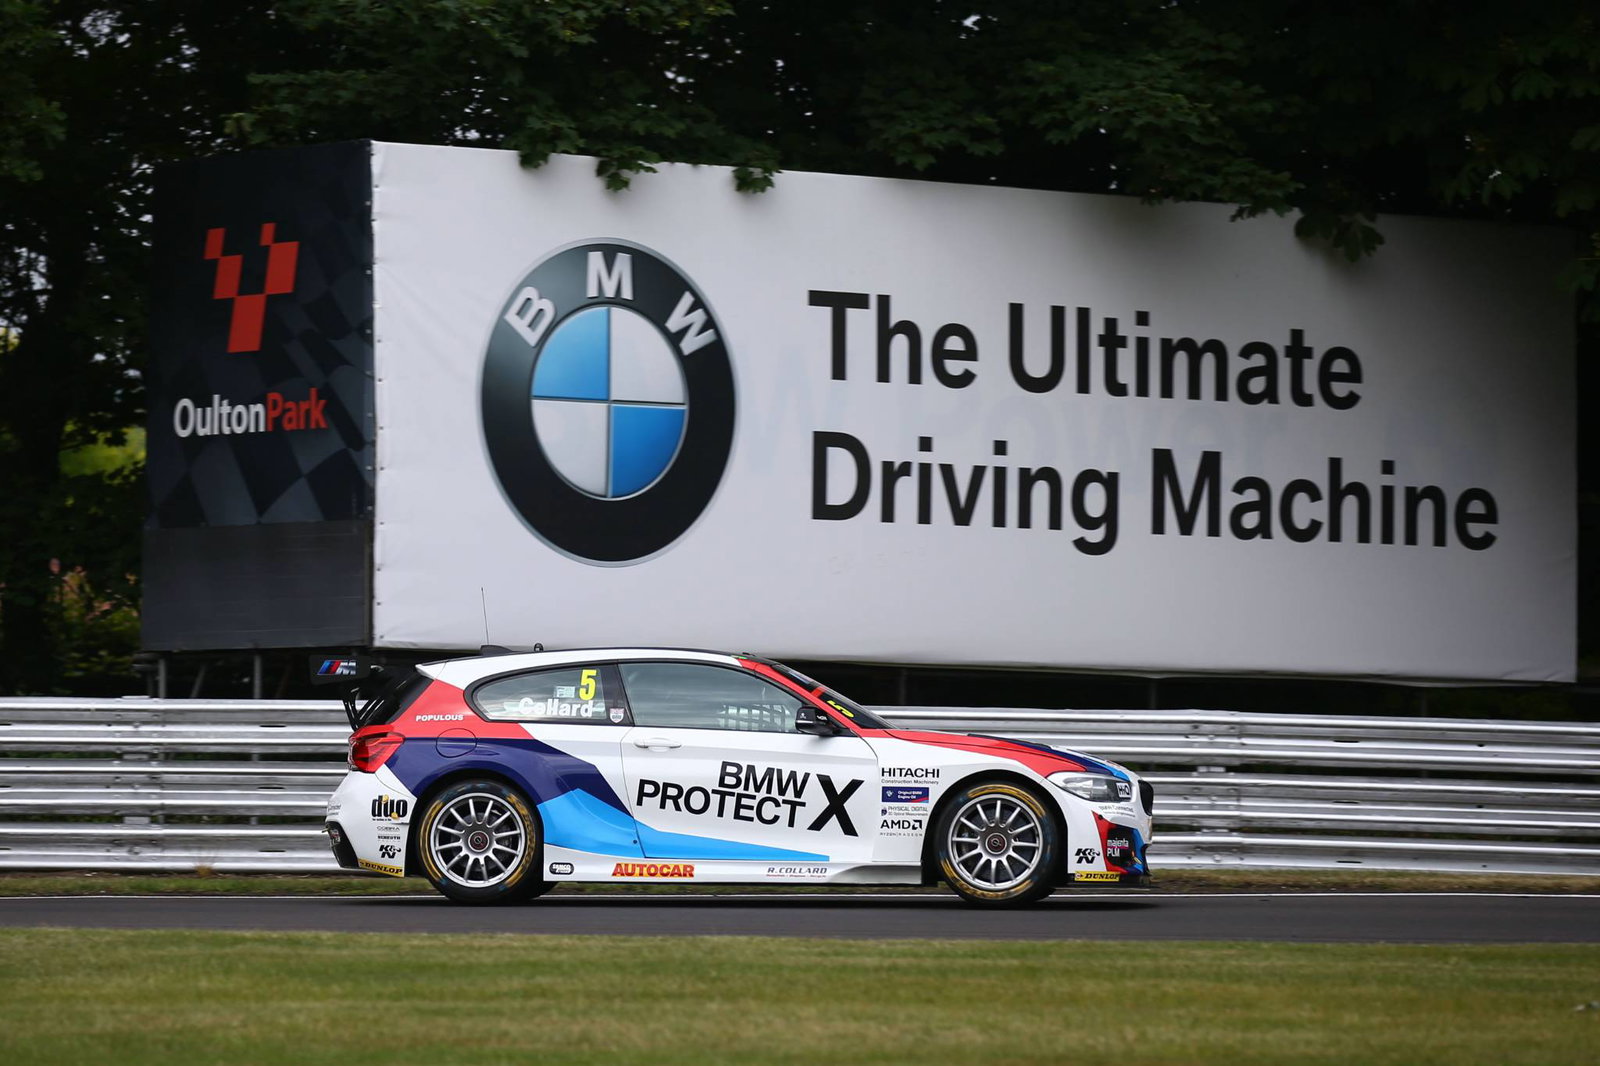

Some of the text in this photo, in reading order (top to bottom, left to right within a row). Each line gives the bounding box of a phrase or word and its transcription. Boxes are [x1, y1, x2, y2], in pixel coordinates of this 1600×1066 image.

[503, 251, 718, 356] BMW
[808, 289, 1364, 411] The Ultimate
[811, 430, 1499, 556] Driving Machine
[579, 669, 597, 701] 5
[415, 714, 464, 722] POPULOUS
[519, 697, 594, 718] Collard
[826, 700, 855, 718] 5
[718, 761, 810, 799] BMW
[881, 767, 940, 778] HITACHI
[371, 794, 408, 818] duo
[636, 779, 806, 829] PROTECT
[807, 773, 865, 837] X
[880, 819, 911, 830] AMD
[1075, 848, 1101, 864] K&N
[364, 861, 403, 874] DUNLOP
[612, 862, 695, 878] AUTOCAR
[1084, 871, 1120, 880] DUNLOP
